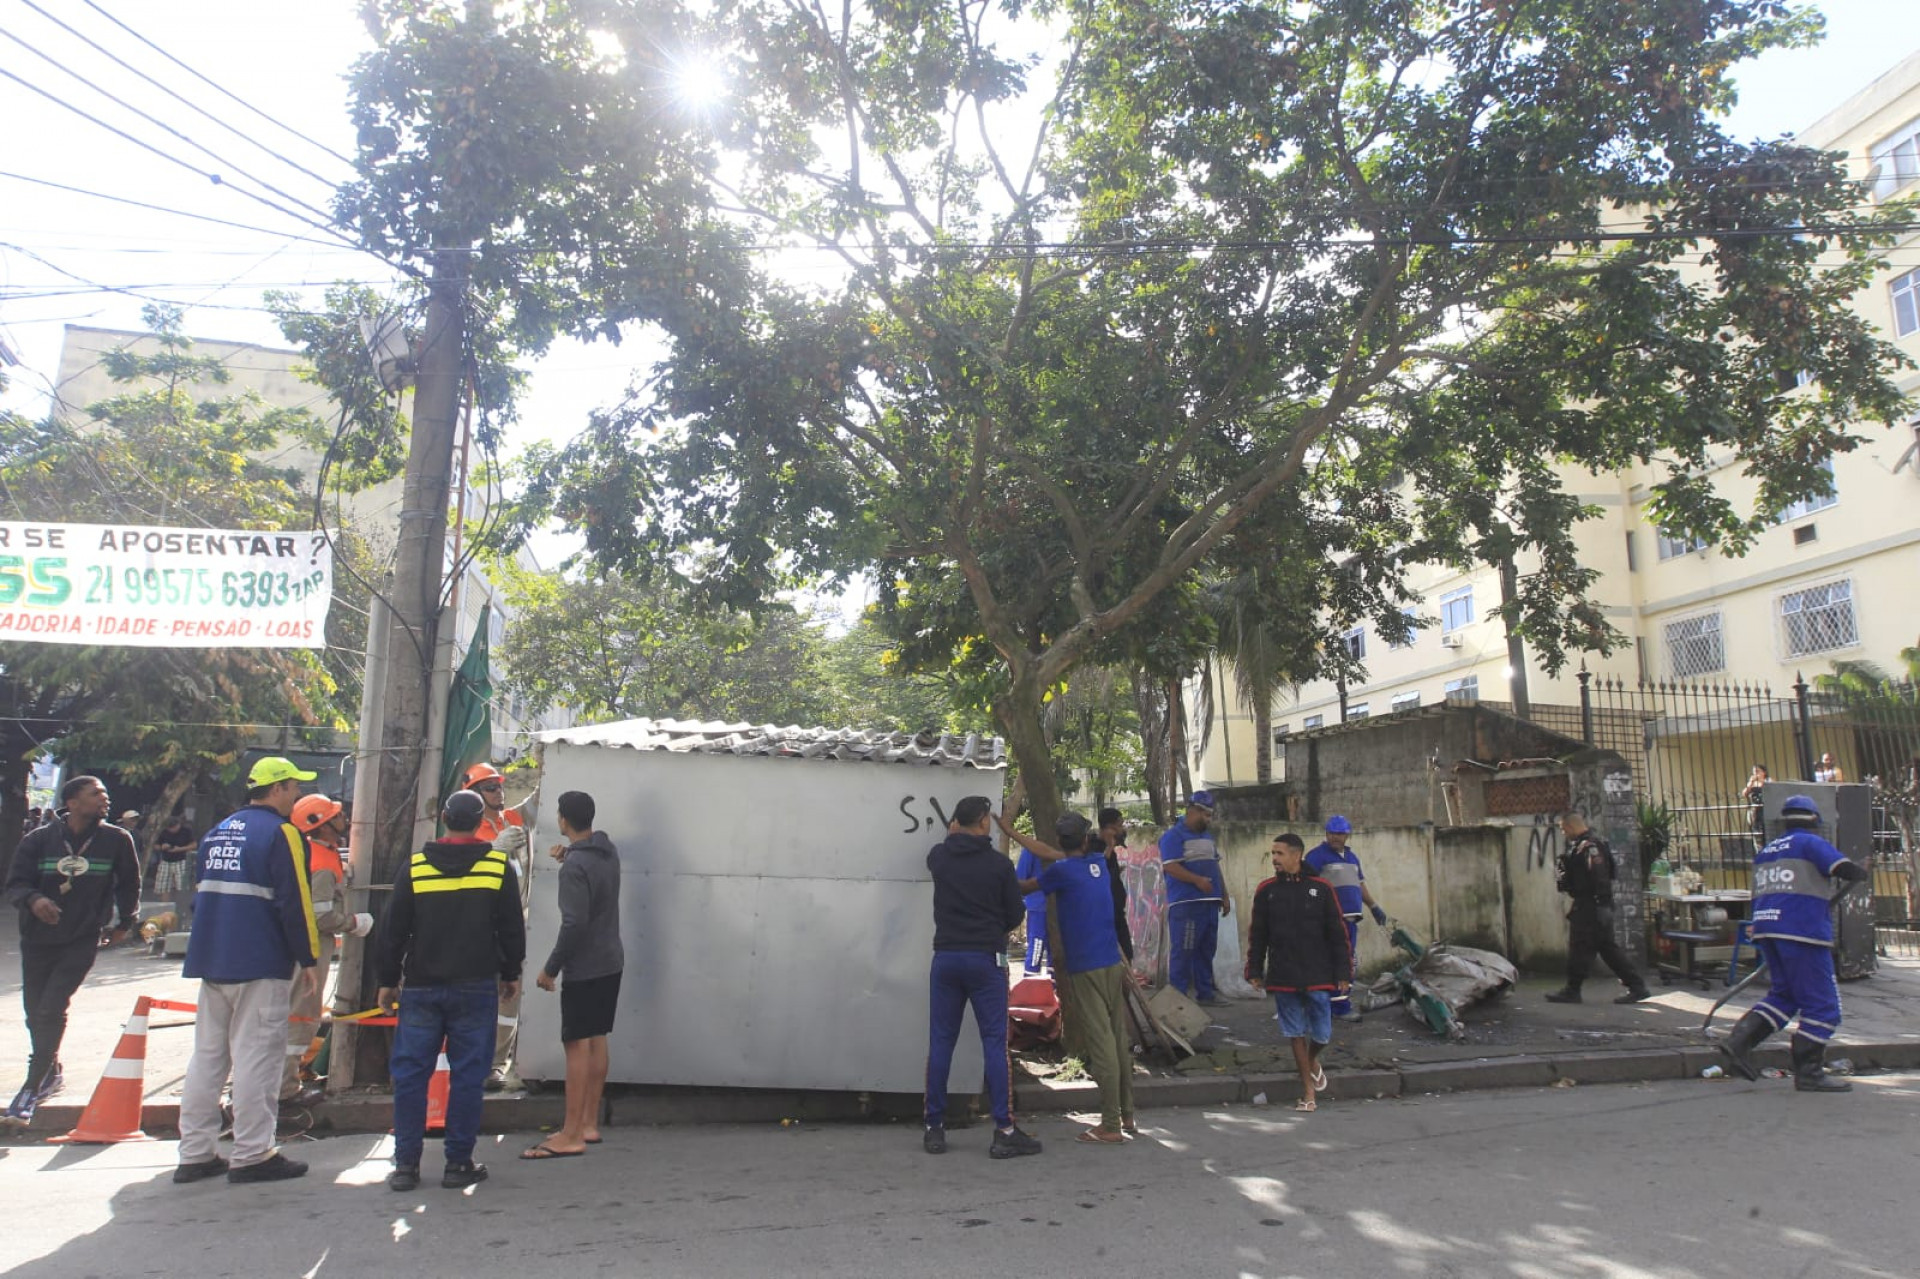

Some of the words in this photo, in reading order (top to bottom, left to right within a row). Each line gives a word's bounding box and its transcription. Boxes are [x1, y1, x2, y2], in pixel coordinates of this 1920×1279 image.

[24, 528, 66, 549] SE
[98, 529, 297, 558] APOSENTAR
[85, 564, 113, 604] 21
[124, 566, 213, 606] 99575
[221, 570, 290, 608] 6393
[291, 569, 324, 603] ZAP
[0, 612, 82, 634] ADORIA
[96, 615, 159, 636] IDADE
[265, 620, 314, 640] LOAS
